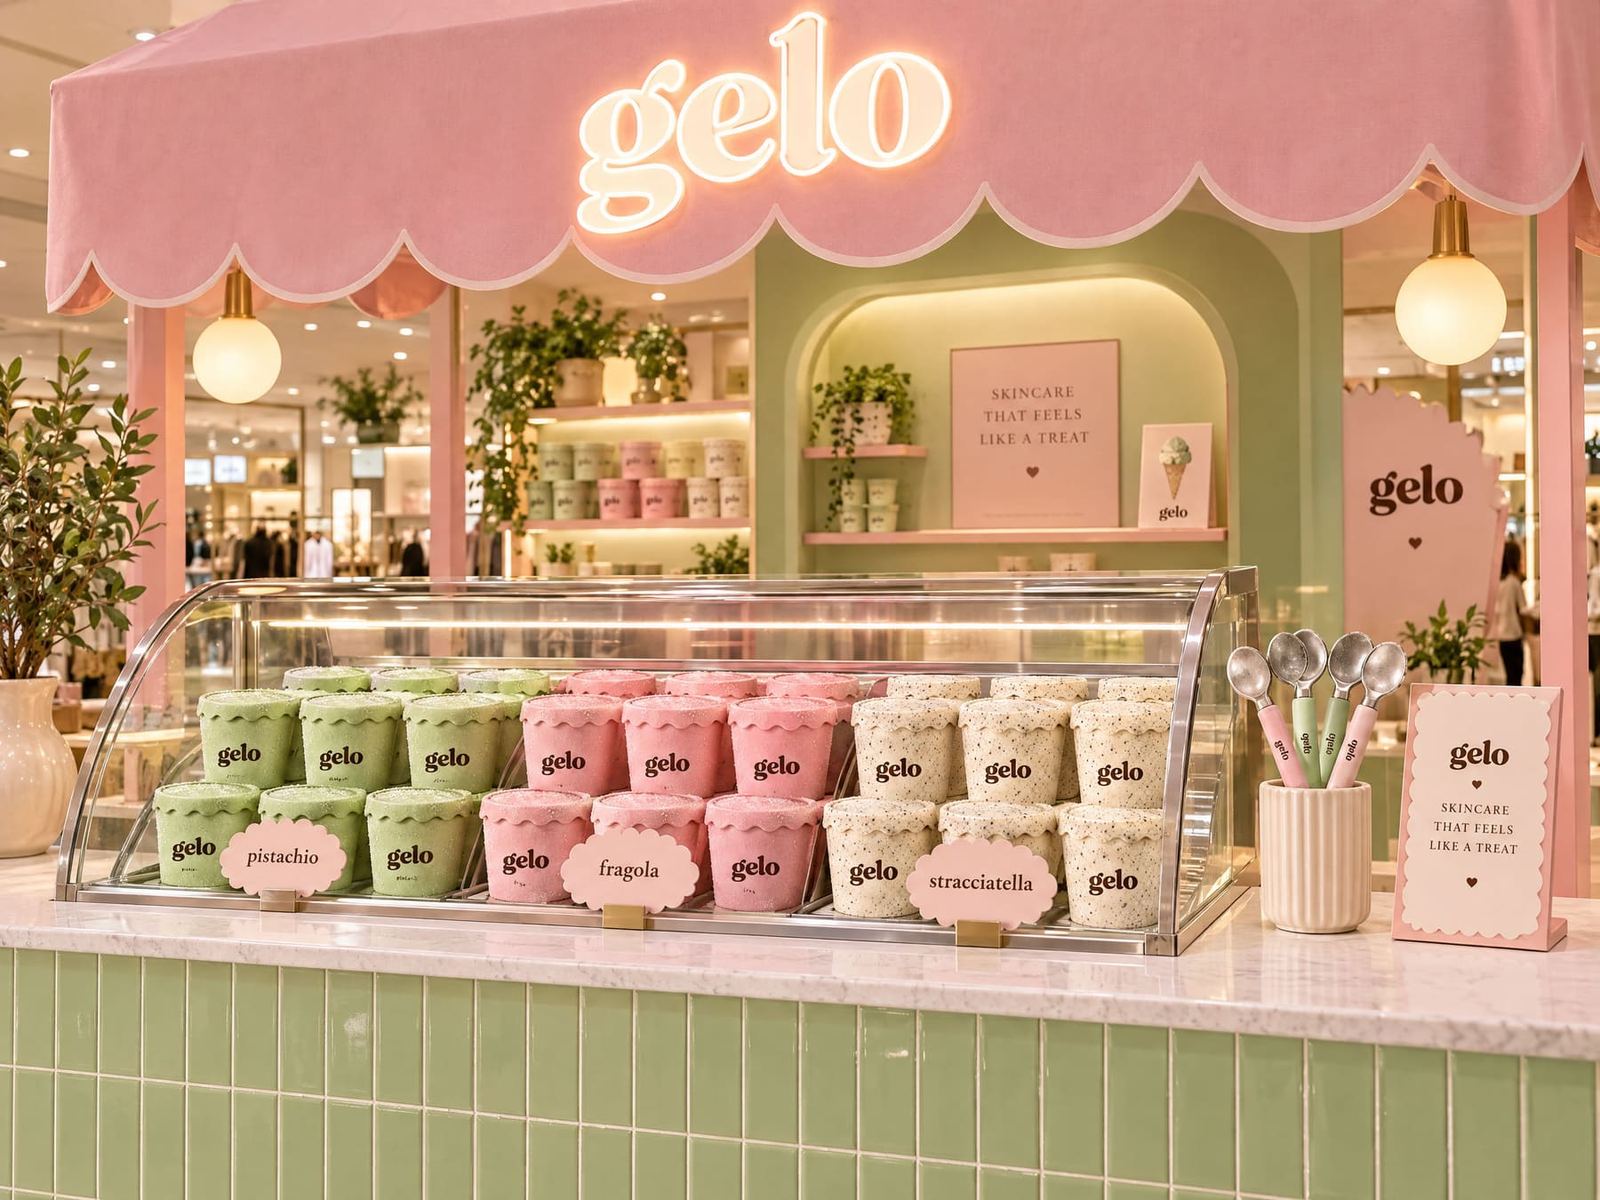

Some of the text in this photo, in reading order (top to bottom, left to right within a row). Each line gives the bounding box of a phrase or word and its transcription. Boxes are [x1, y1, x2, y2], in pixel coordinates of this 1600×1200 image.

[576, 11, 951, 234] gelo
[991, 386, 1075, 400] SKINCARE
[984, 408, 1082, 423] THAT FEELS
[980, 431, 1090, 446] LIKE A TREAT
[1369, 464, 1464, 517] gelo
[1159, 505, 1188, 522] gelo
[218, 743, 261, 768] gelo
[320, 746, 363, 771] gelo
[426, 748, 470, 773] gelo
[541, 751, 586, 776] gelo
[645, 753, 690, 778] gelo
[1449, 739, 1510, 771] gelo
[754, 755, 800, 782] gelo
[876, 758, 922, 784] gelo
[985, 759, 1032, 785] gelo
[1098, 761, 1144, 787] gelo
[1441, 803, 1510, 815] SKINCARE
[1434, 821, 1514, 835] THAT FEELS
[172, 837, 217, 862] gelo
[247, 848, 319, 867] pistachio
[387, 845, 434, 871] gelo
[1429, 840, 1518, 855] LIKE A TREAT
[502, 849, 549, 875] gelo
[599, 859, 659, 882] fragola
[732, 855, 780, 882] gelo
[850, 860, 898, 886] gelo
[929, 873, 1033, 892] stracciatella
[1089, 869, 1139, 895] gelo
